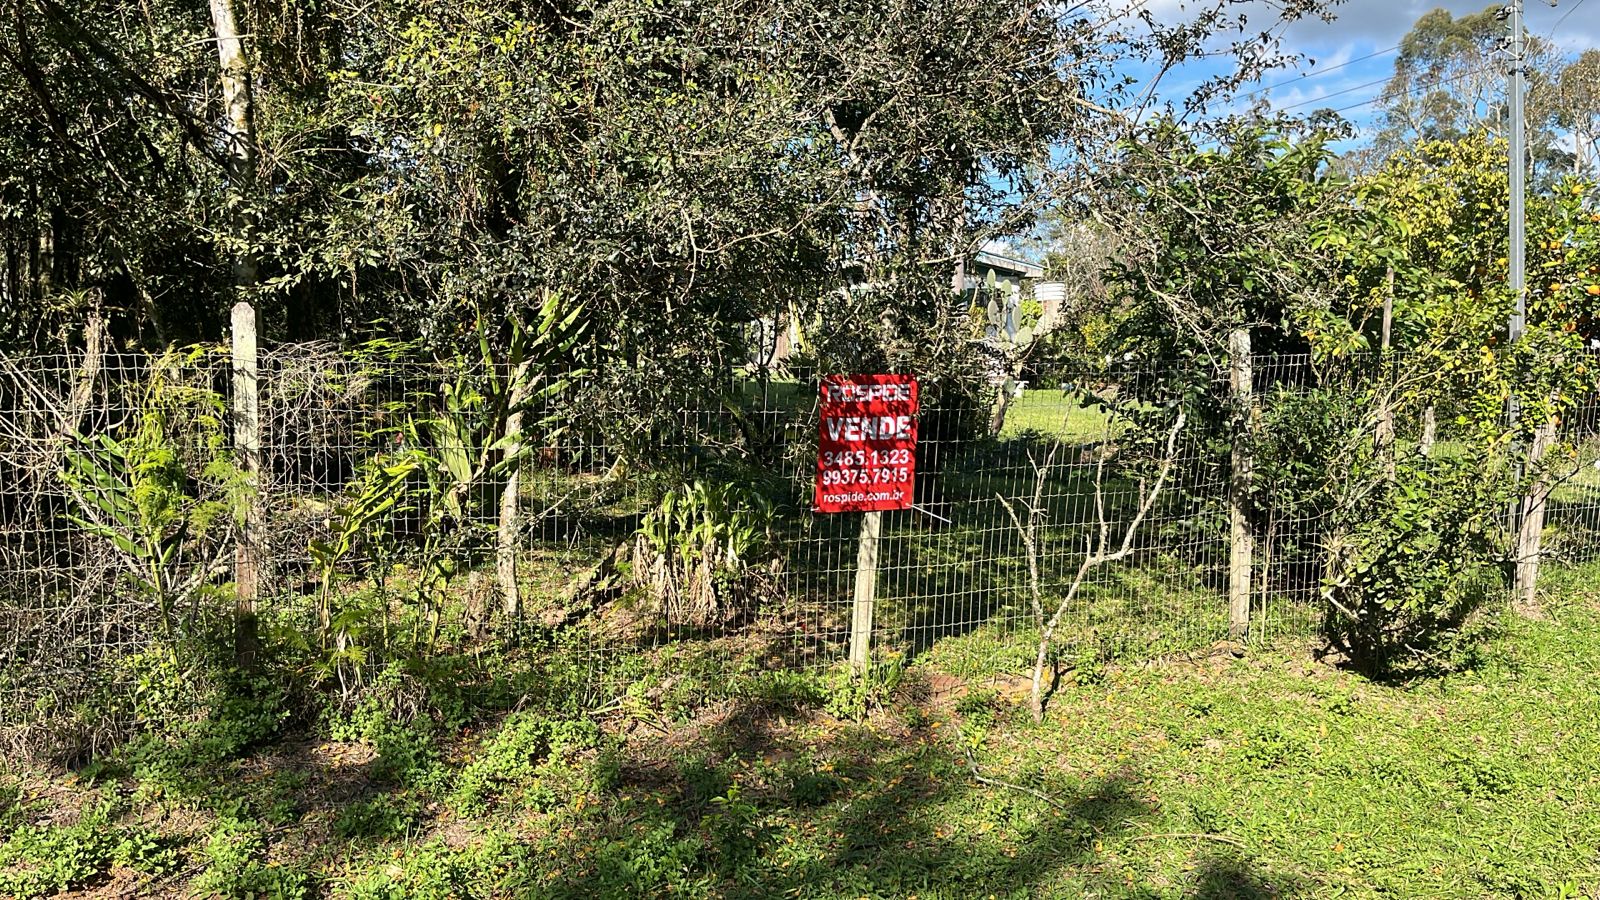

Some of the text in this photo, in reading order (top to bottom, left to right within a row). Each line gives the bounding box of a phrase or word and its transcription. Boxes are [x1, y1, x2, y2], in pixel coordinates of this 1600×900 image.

[827, 416, 911, 441] VENDE
[824, 449, 909, 466] 3485.1323
[823, 467, 908, 485] 99375.7915
[823, 490, 904, 503] rospide.com.br
